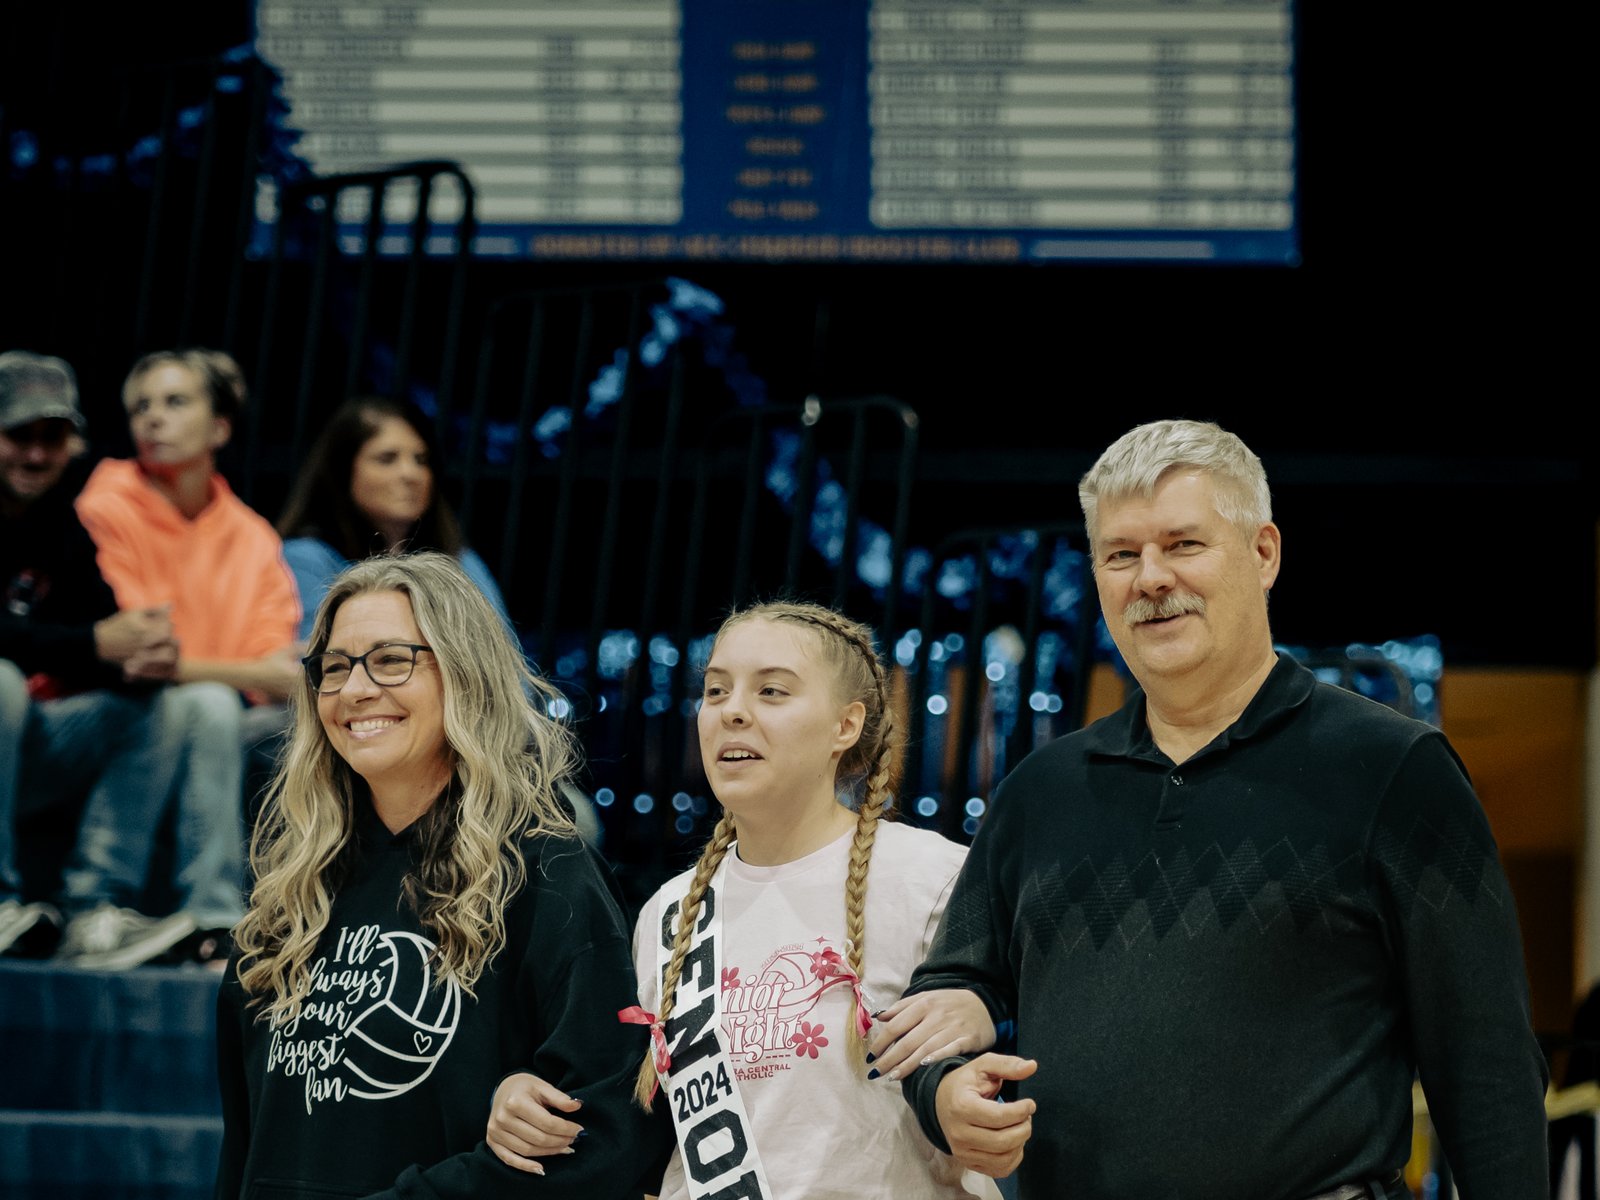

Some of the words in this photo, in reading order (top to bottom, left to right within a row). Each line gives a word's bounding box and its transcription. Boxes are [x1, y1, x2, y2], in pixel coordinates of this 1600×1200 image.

[333, 924, 380, 965] I'll
[721, 975, 795, 1014] nior
[267, 1030, 345, 1076] biggest
[747, 1063, 791, 1074] CENTRAL
[305, 1067, 348, 1115] fan
[674, 1061, 733, 1123] 2024
[736, 1071, 774, 1081] THOLIC
